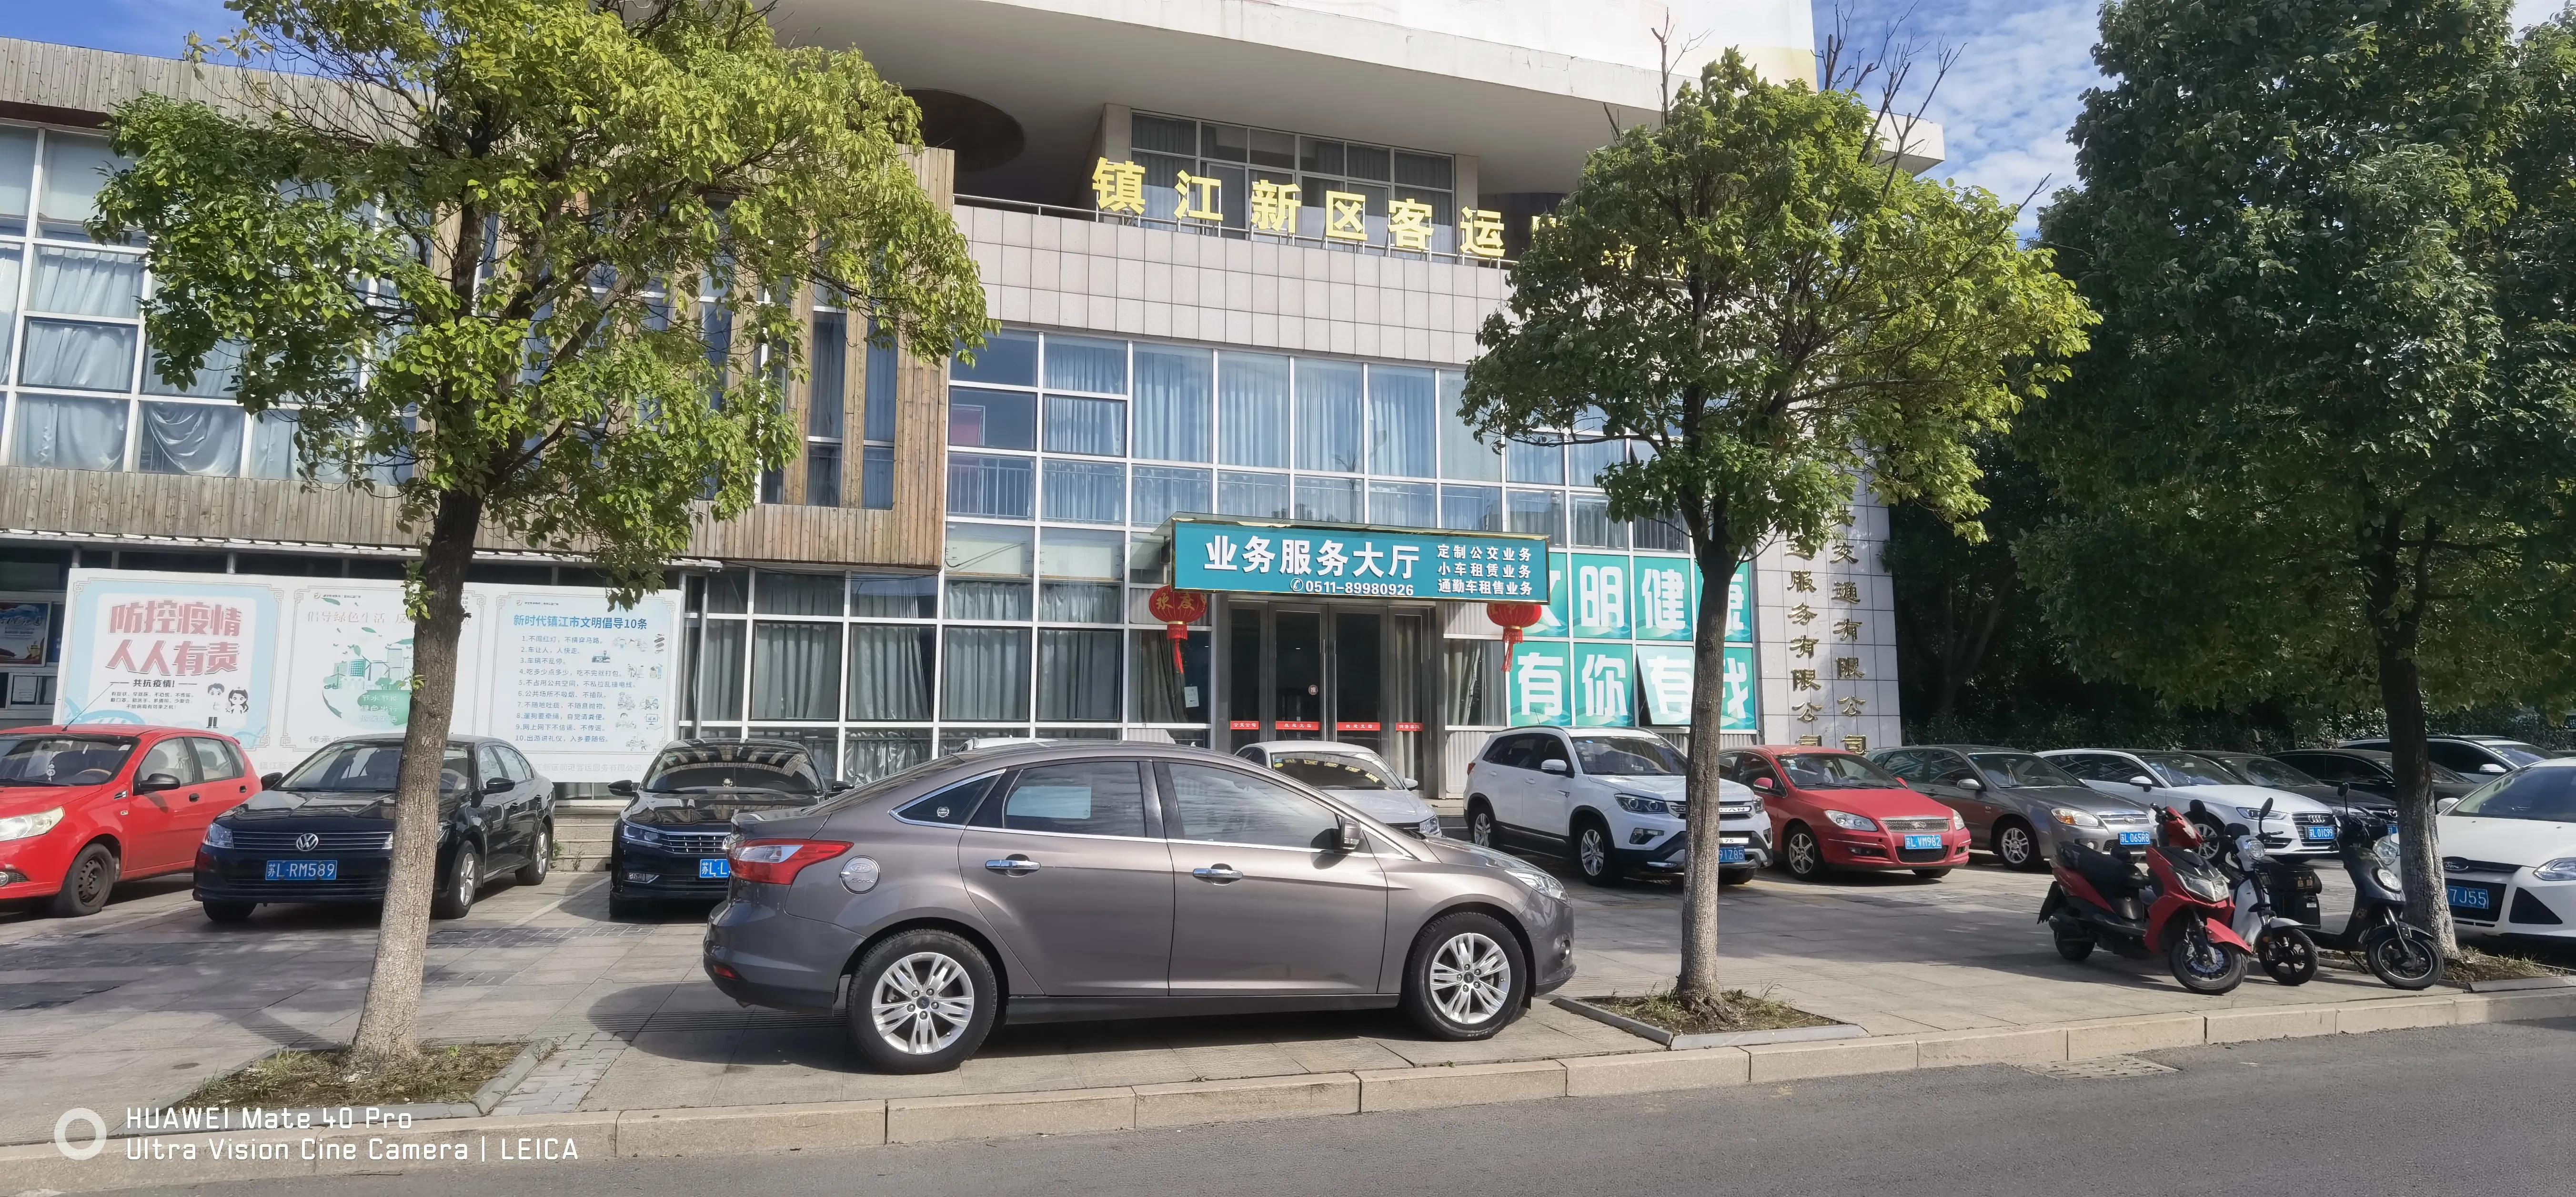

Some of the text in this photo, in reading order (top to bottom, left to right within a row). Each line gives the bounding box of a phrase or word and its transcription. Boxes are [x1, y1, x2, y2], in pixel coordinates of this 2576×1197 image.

[1204, 535, 1419, 579] 业务服务大厅
[1437, 544, 1531, 561] 定制公交业务
[1438, 561, 1531, 578] 小车租赁业务
[1306, 580, 1414, 596] 0511-89980926
[1438, 578, 1532, 596] 通勤车租售业务
[108, 598, 242, 637] 防控疫情
[513, 614, 647, 630] 新时代镇江市文明倡导10条
[105, 639, 240, 676] 人人有责
[1719, 849, 1744, 860] 91Z85
[2446, 888, 2487, 906] 7J55
